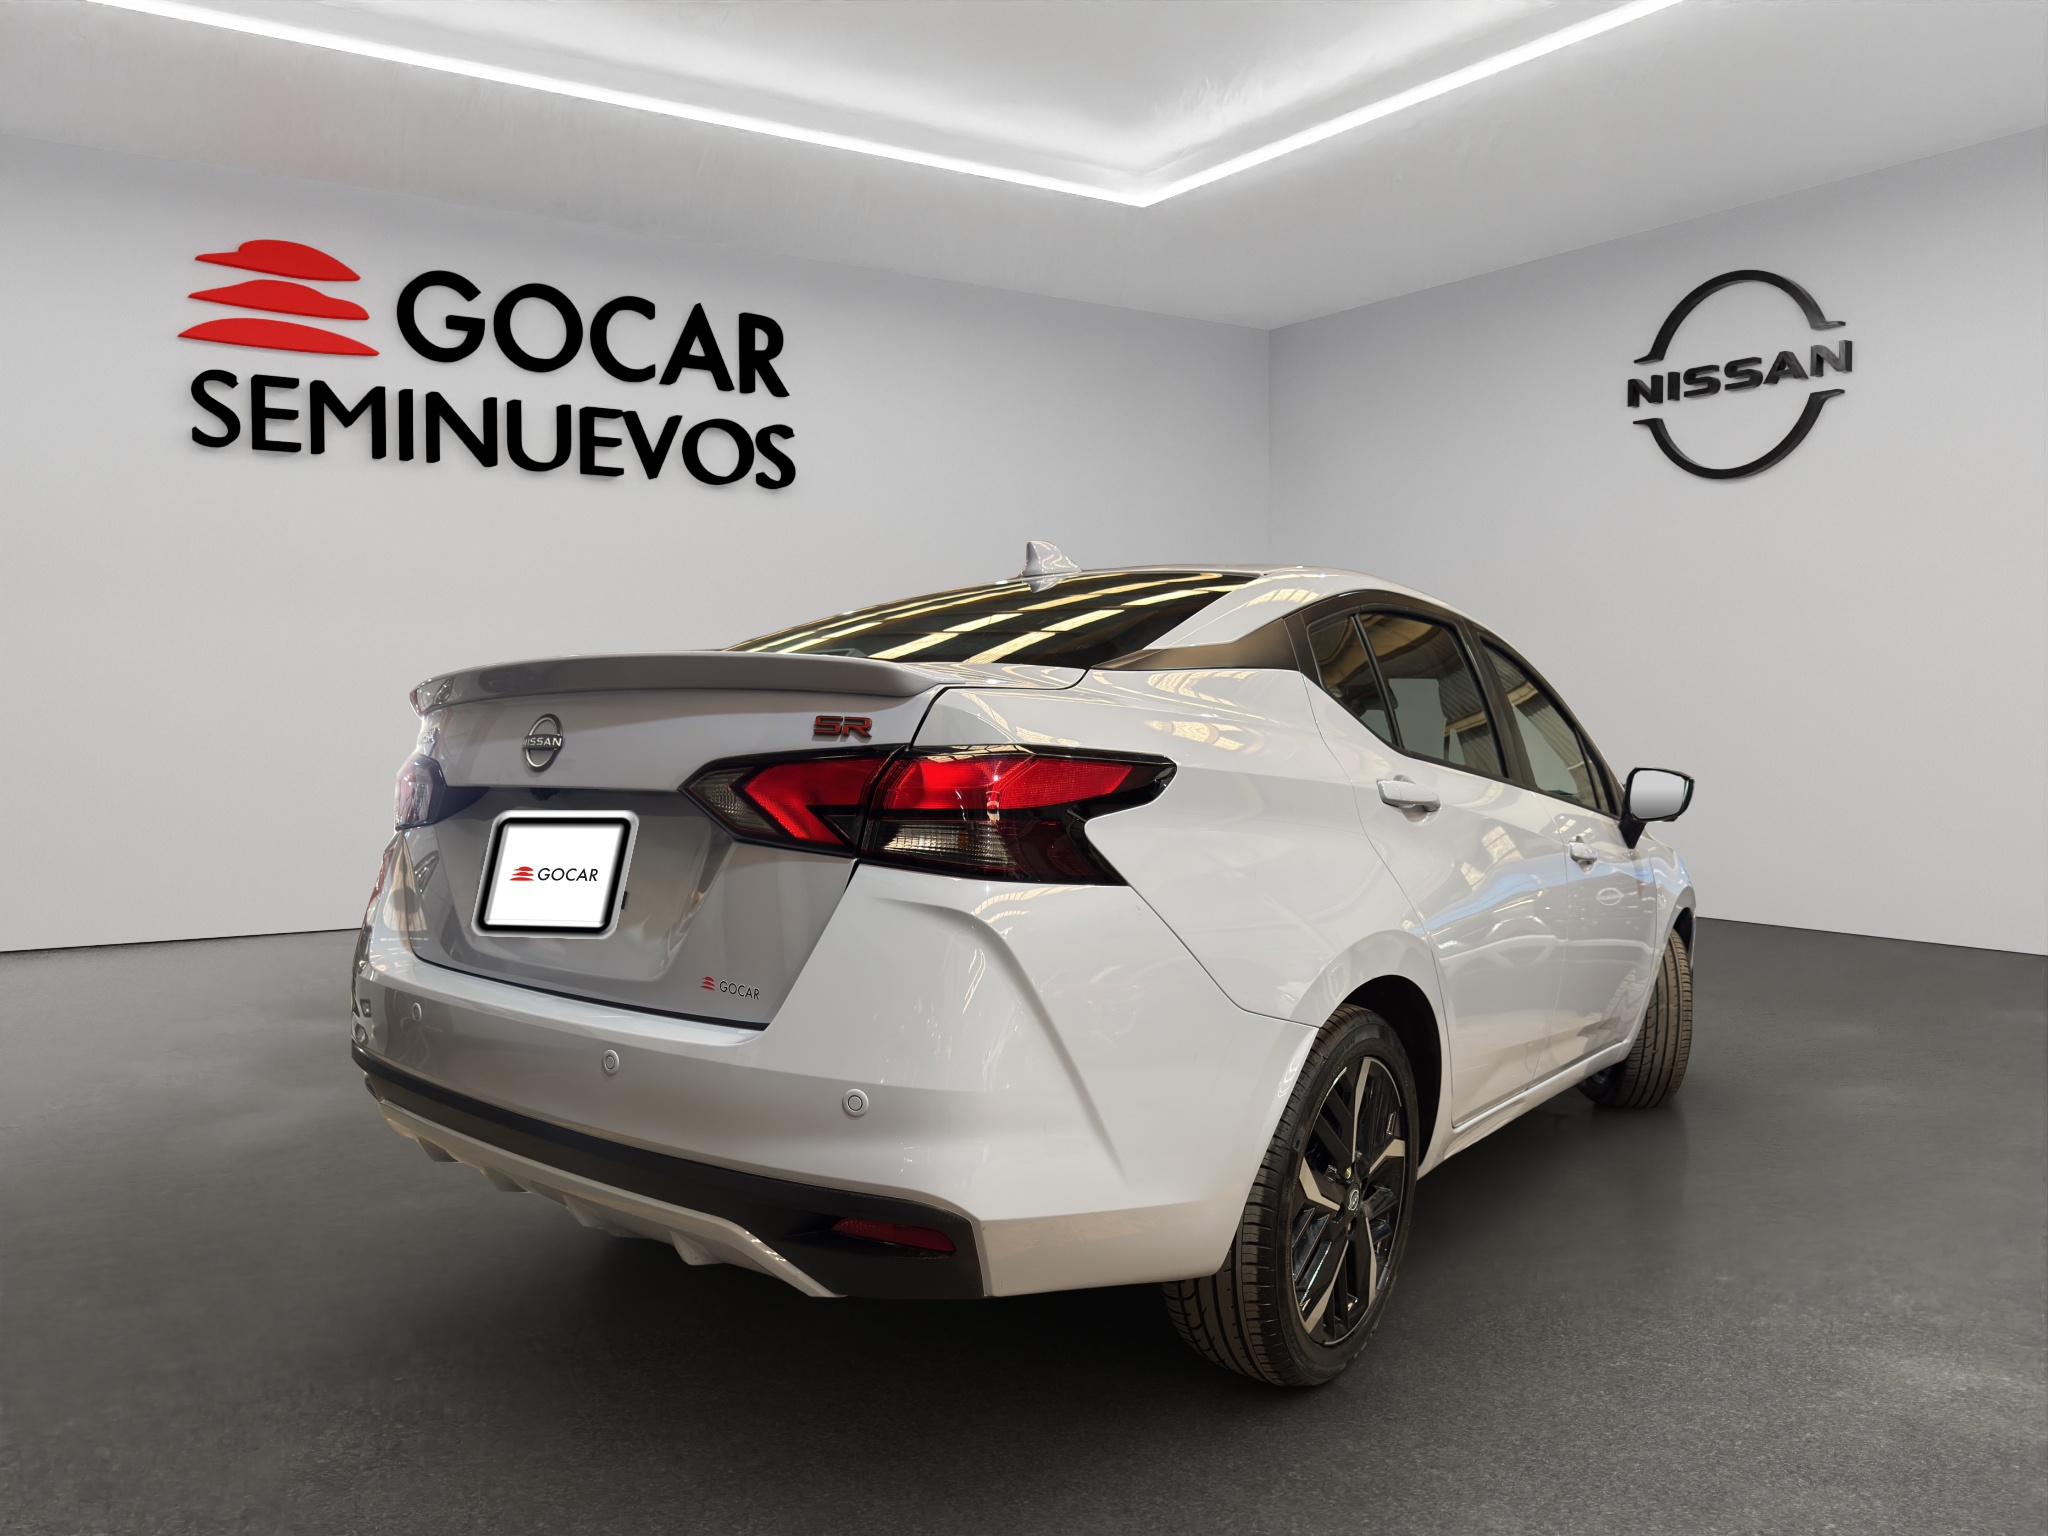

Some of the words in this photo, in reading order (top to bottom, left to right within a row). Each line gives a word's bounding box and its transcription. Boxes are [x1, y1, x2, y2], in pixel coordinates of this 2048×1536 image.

[397, 270, 790, 397] GOCAR
[1627, 339, 1853, 408] NISSAN
[191, 369, 797, 489] SEMINUEVOS
[813, 715, 873, 738] SR
[537, 867, 599, 881] GOCAR
[719, 980, 760, 1001] GOCAR
